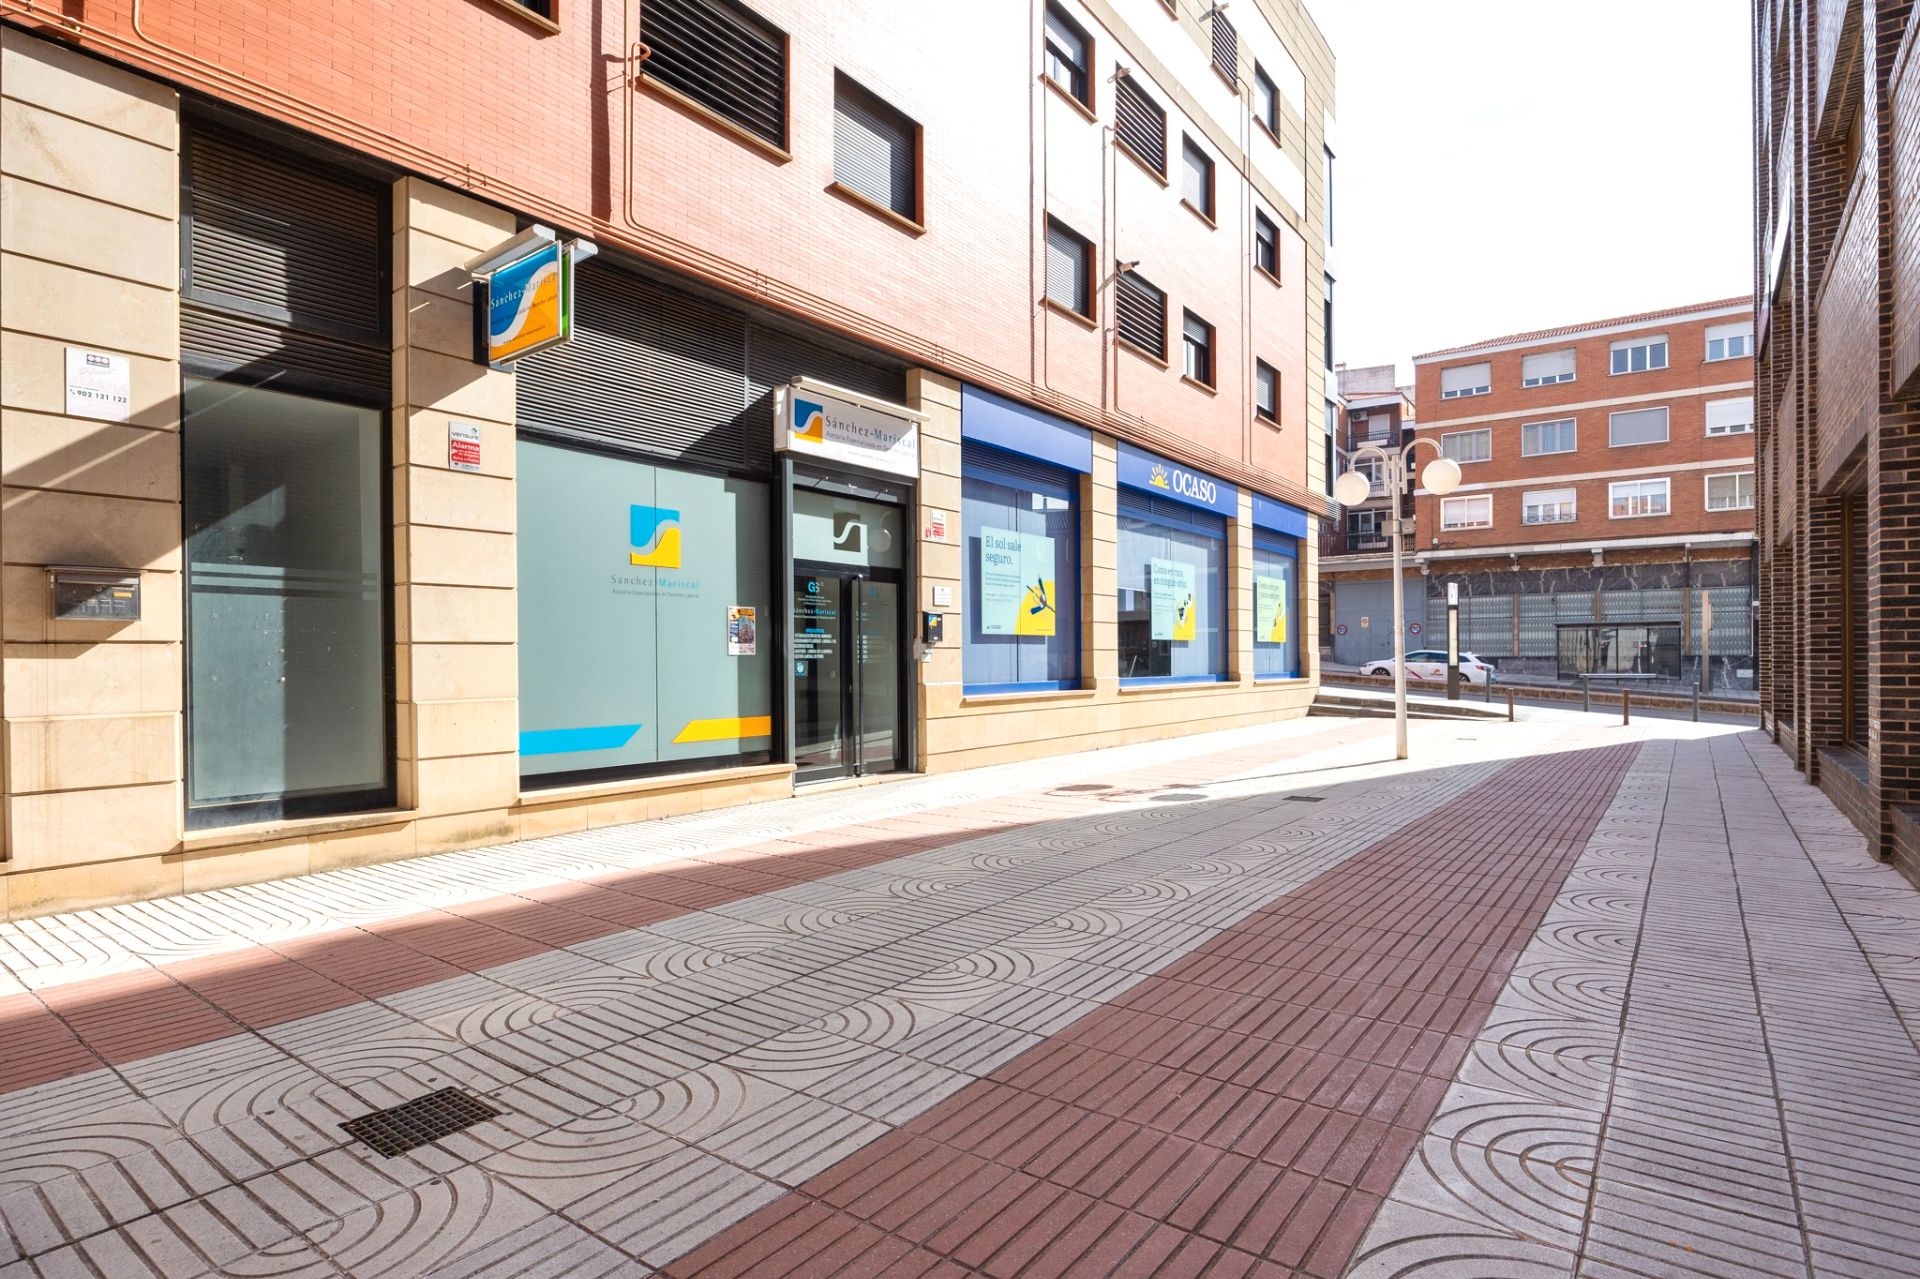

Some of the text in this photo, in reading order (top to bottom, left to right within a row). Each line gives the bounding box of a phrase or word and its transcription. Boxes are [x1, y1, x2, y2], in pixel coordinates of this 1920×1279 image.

[77, 390, 92, 398] 902
[825, 415, 915, 449] Sánchez-Mariscal
[1172, 469, 1217, 504] OCASO
[985, 535, 1022, 552] El sol sale
[985, 552, 1014, 566] seguro.
